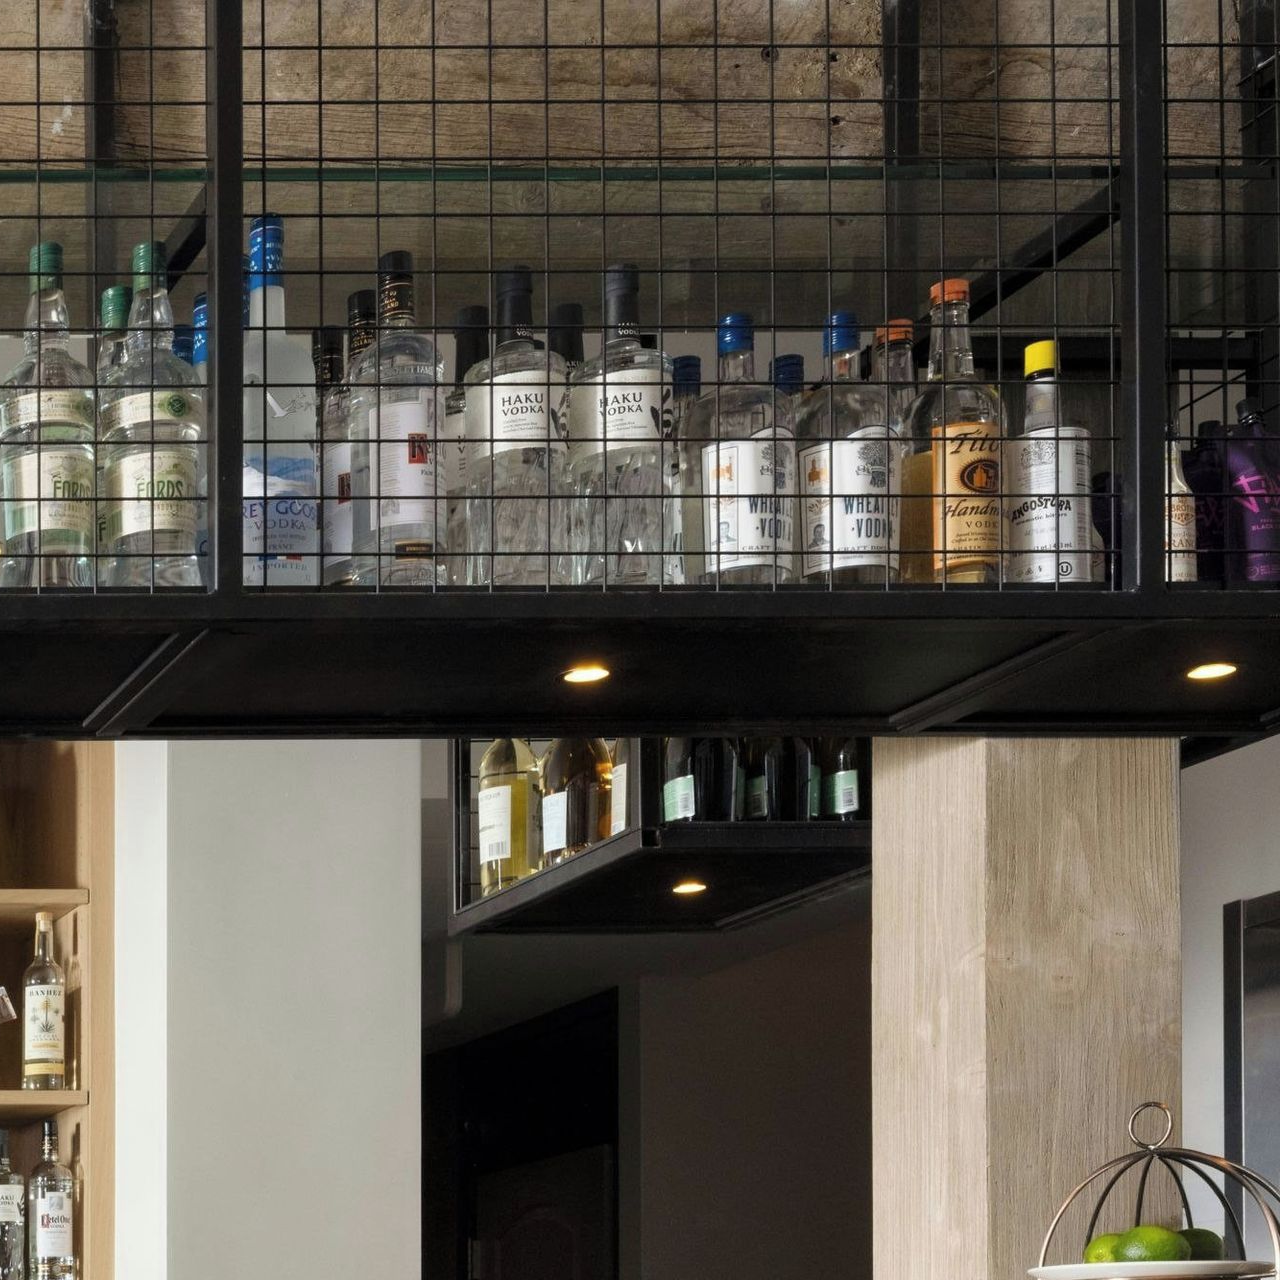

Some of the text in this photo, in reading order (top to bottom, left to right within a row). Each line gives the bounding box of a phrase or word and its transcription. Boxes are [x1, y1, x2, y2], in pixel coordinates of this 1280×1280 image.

[502, 392, 544, 407] HAKU
[599, 391, 643, 409] HAKU
[502, 404, 545, 417] VODKA
[599, 403, 644, 417] VODKA
[949, 429, 1000, 455] Tito
[275, 500, 317, 521] GOOS
[1011, 496, 1072, 523] ANGOSTURA
[965, 520, 999, 529] VODK
[29, 988, 62, 997] BANHEZ
